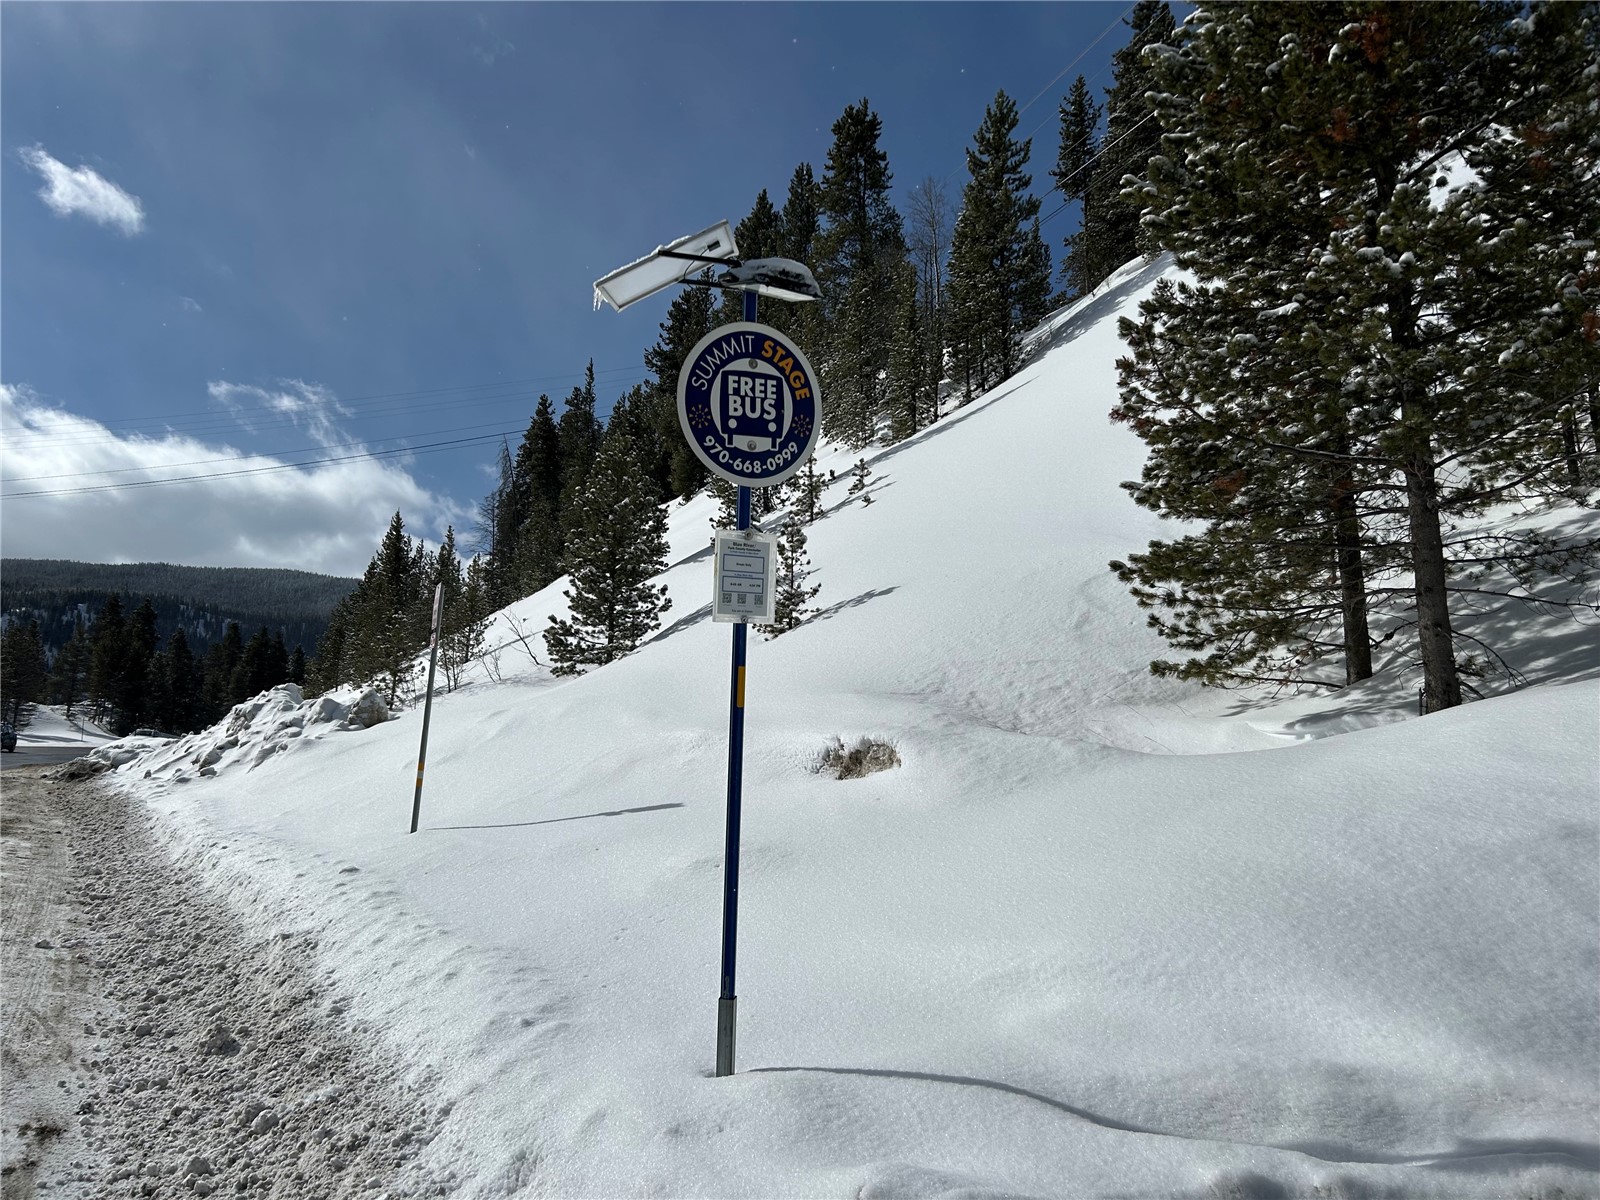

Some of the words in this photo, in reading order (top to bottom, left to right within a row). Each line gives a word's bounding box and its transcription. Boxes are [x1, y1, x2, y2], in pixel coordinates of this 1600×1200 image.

[691, 335, 755, 391] SUMMIT
[761, 339, 811, 401] STAGE
[727, 374, 777, 400] FREE
[728, 395, 777, 420] BUS
[703, 435, 799, 474] 970-668-0999
